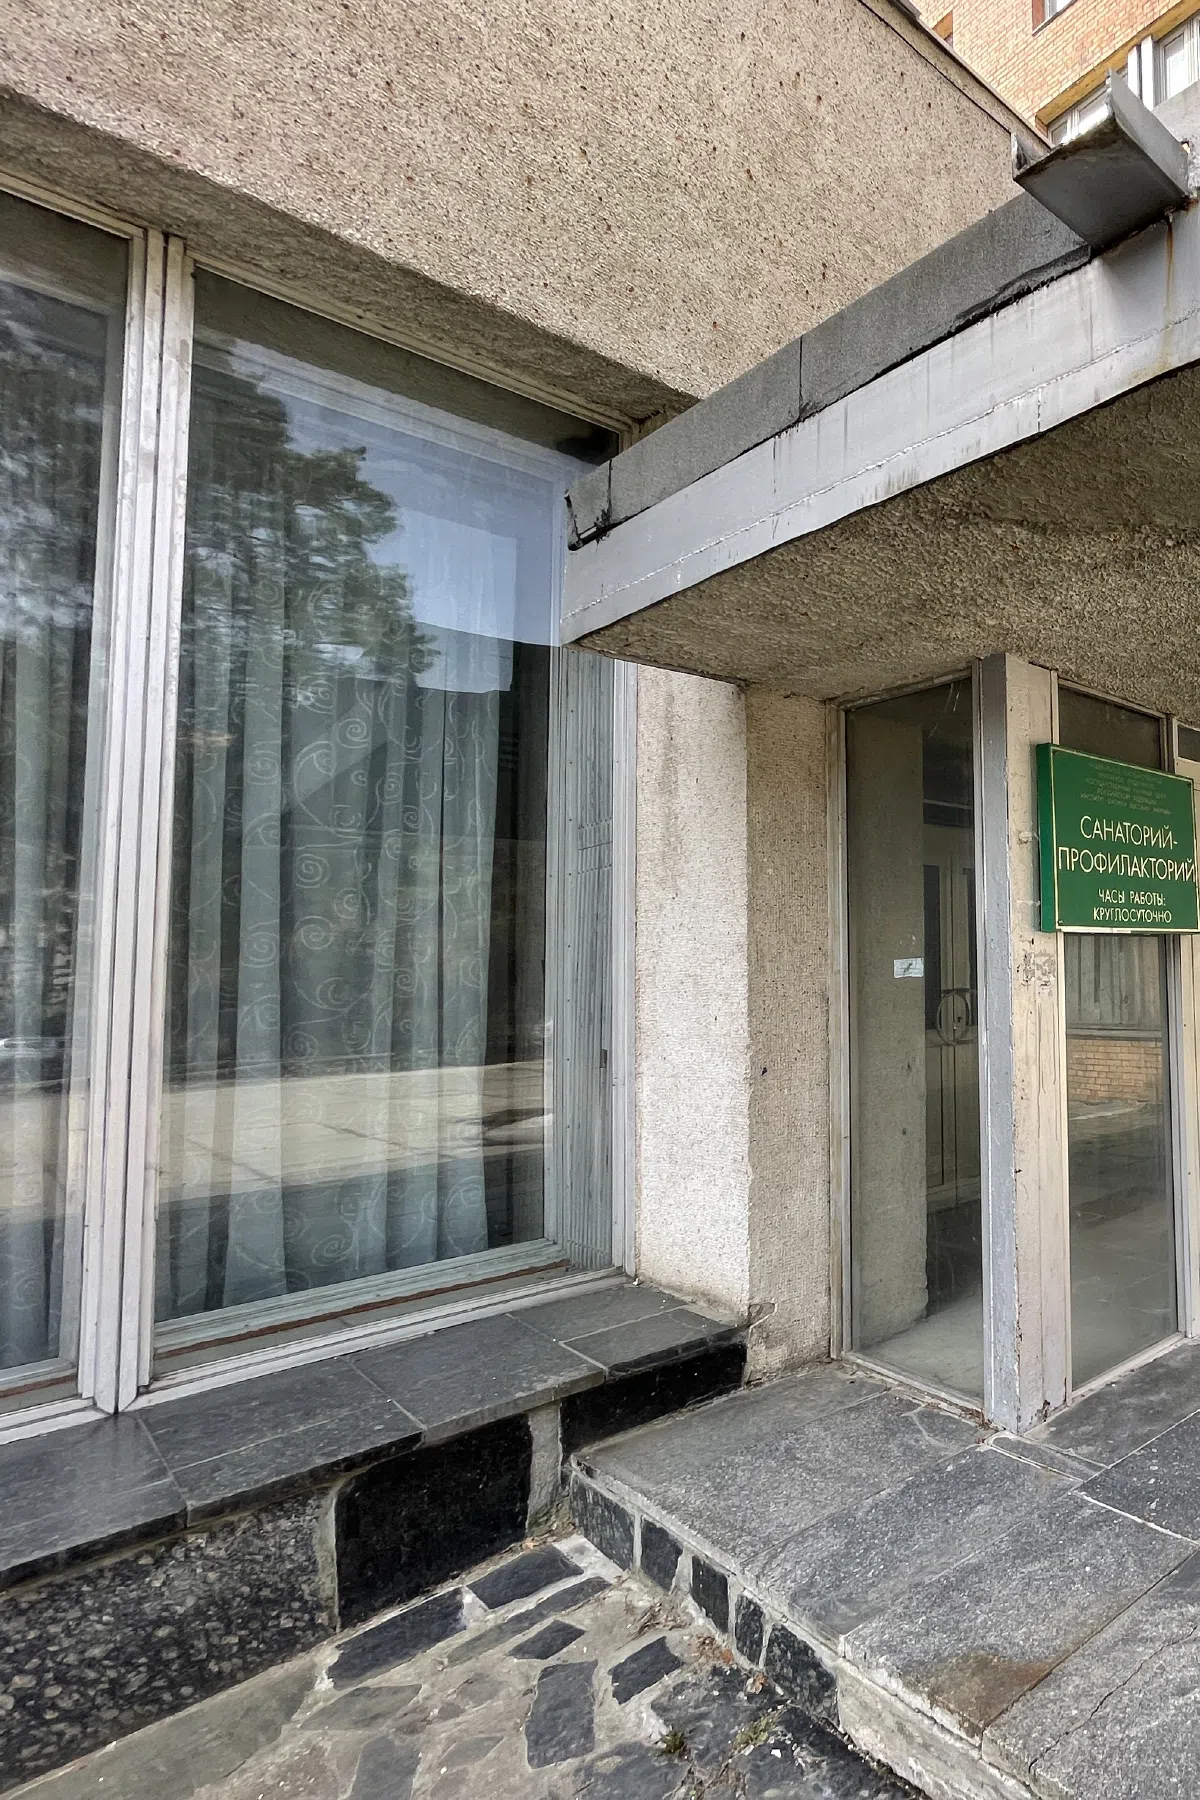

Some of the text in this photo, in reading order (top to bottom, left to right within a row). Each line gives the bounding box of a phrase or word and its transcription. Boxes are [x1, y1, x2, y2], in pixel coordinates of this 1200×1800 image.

[1080, 815, 1178, 850] САНАТОРИЙ-
[1058, 846, 1196, 883] ПРОФИЛАКТОРИЙ
[1098, 889, 1166, 907] ЧАСЫ РАБОТЫ:
[1093, 907, 1172, 924] КРУГЛОСУТОЧНО
